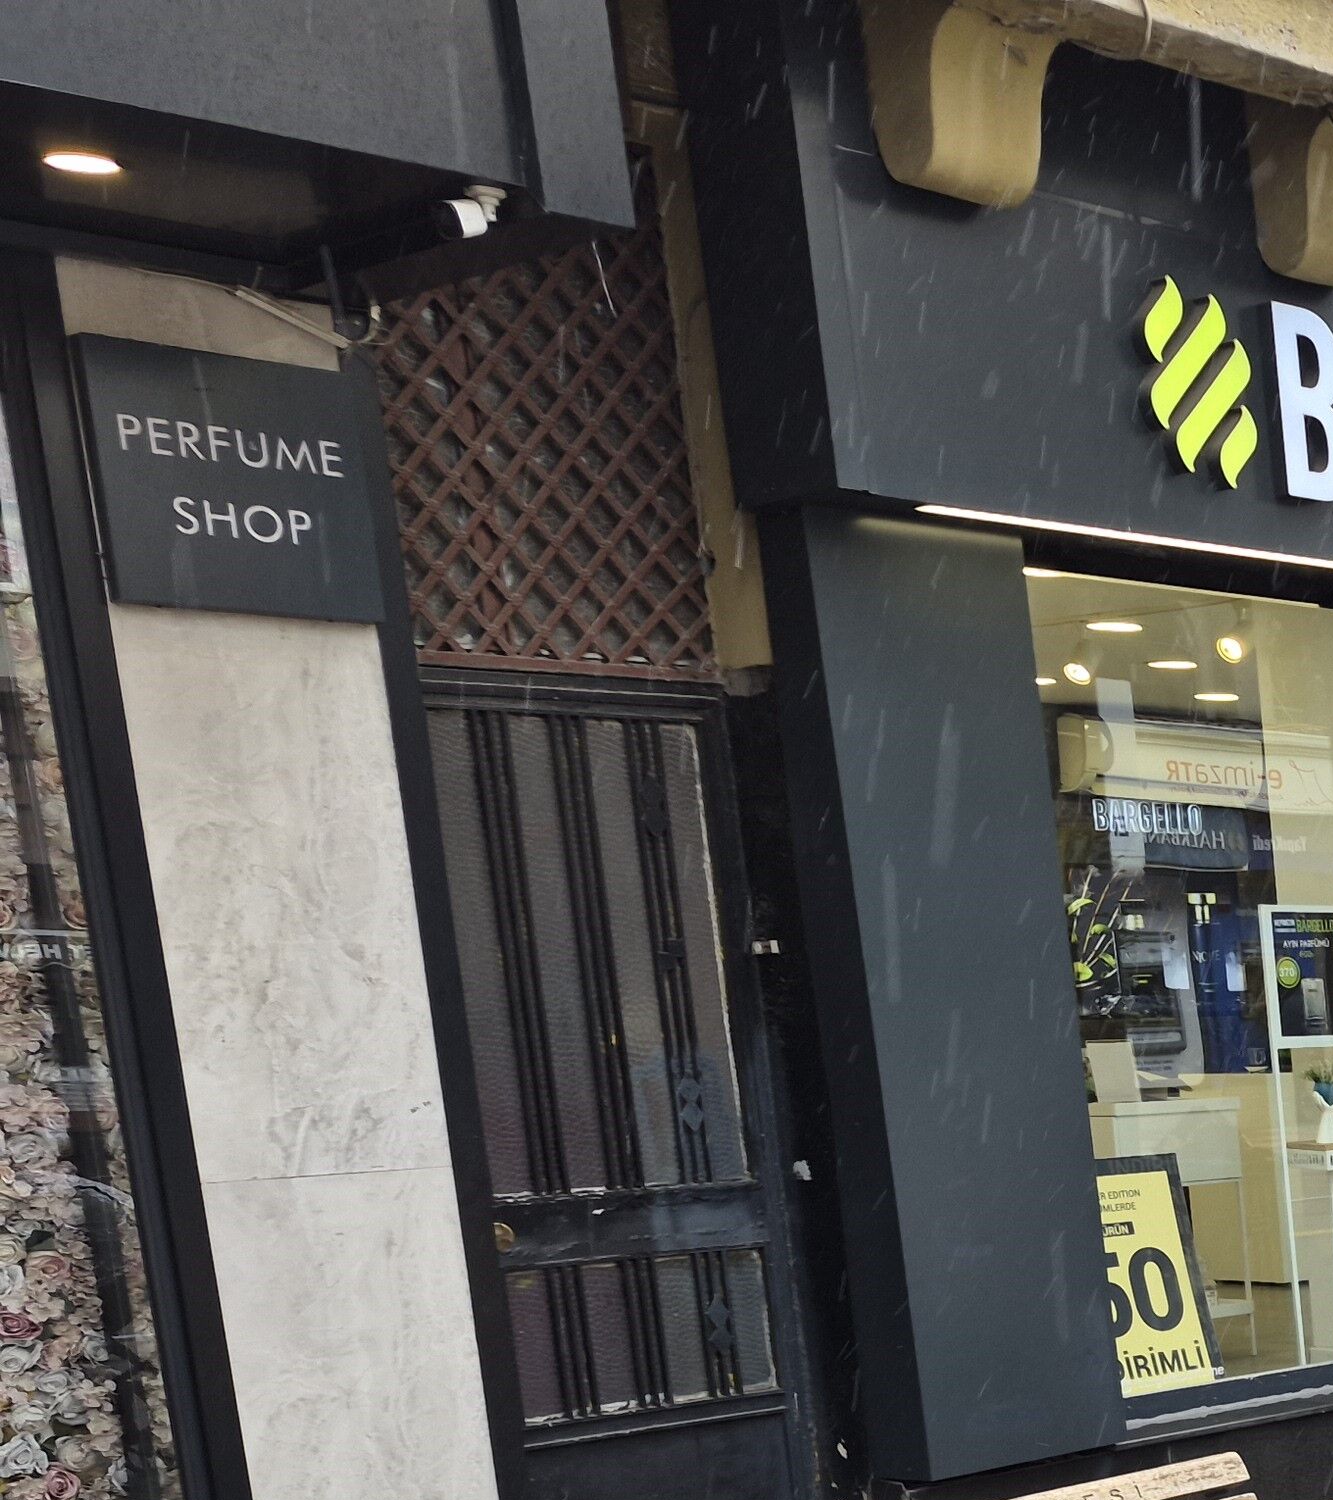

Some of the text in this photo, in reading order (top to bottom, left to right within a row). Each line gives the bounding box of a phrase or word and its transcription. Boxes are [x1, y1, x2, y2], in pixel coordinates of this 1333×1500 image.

[116, 412, 345, 478] PERFUME
[172, 496, 312, 545] SHOP
[1092, 798, 1203, 836] BARGELLO
[1108, 1189, 1141, 1200] EDITION
[1119, 1340, 1206, 1381] İRİMLİ
